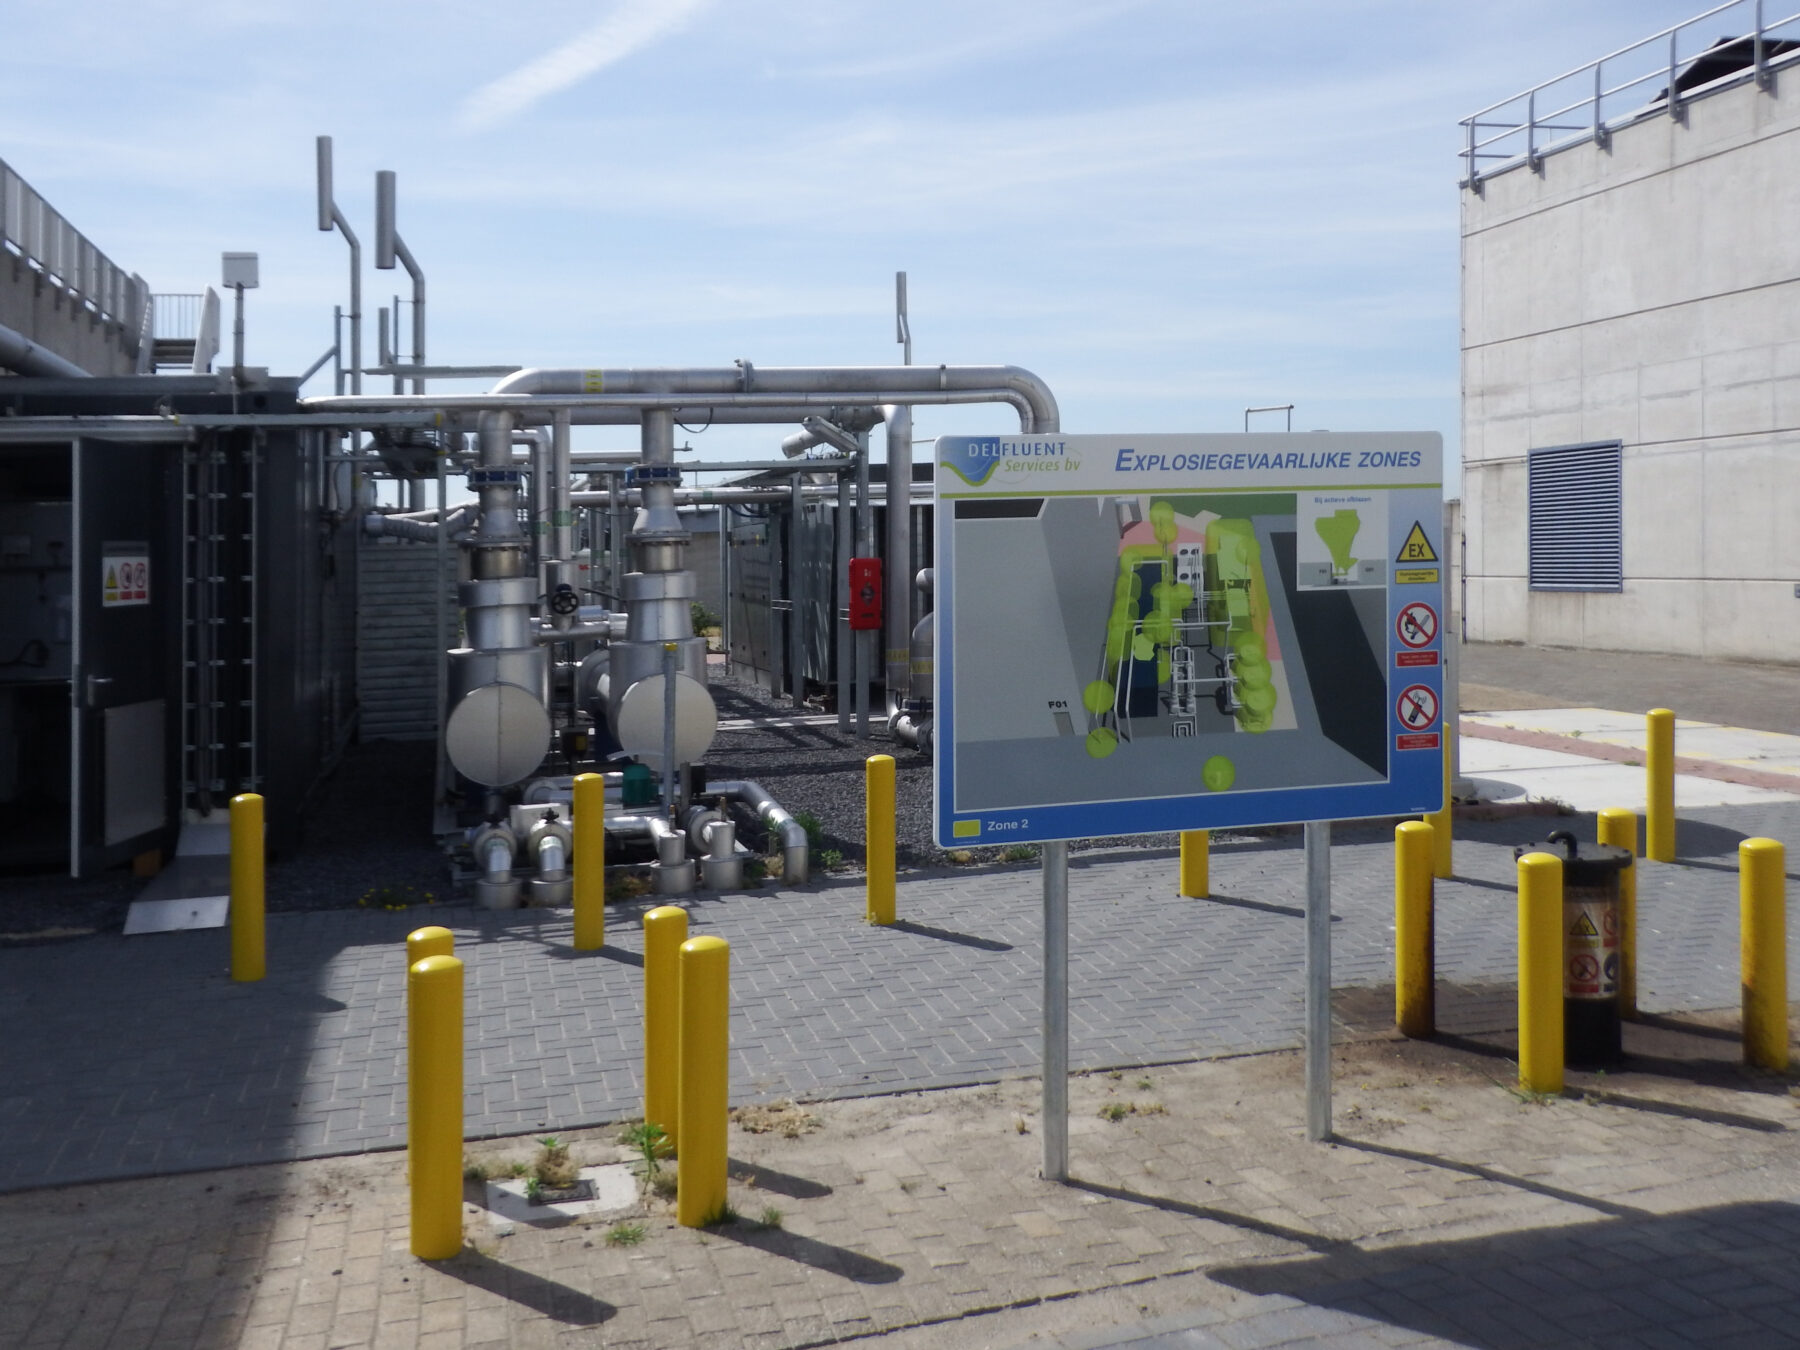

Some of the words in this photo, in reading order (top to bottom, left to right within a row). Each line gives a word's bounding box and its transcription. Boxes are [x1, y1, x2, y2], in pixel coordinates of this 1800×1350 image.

[968, 442, 1066, 457] DELFLUENT
[1005, 459, 1060, 472] Services
[1065, 459, 1081, 471] bv
[1115, 449, 1351, 472] EXPLOSIEGEVAARLIJKE
[1358, 451, 1421, 468] ZONES
[1408, 543, 1425, 558] EX
[1048, 700, 1068, 709] F01
[987, 821, 1018, 831] Zone
[1021, 819, 1029, 829] 2
